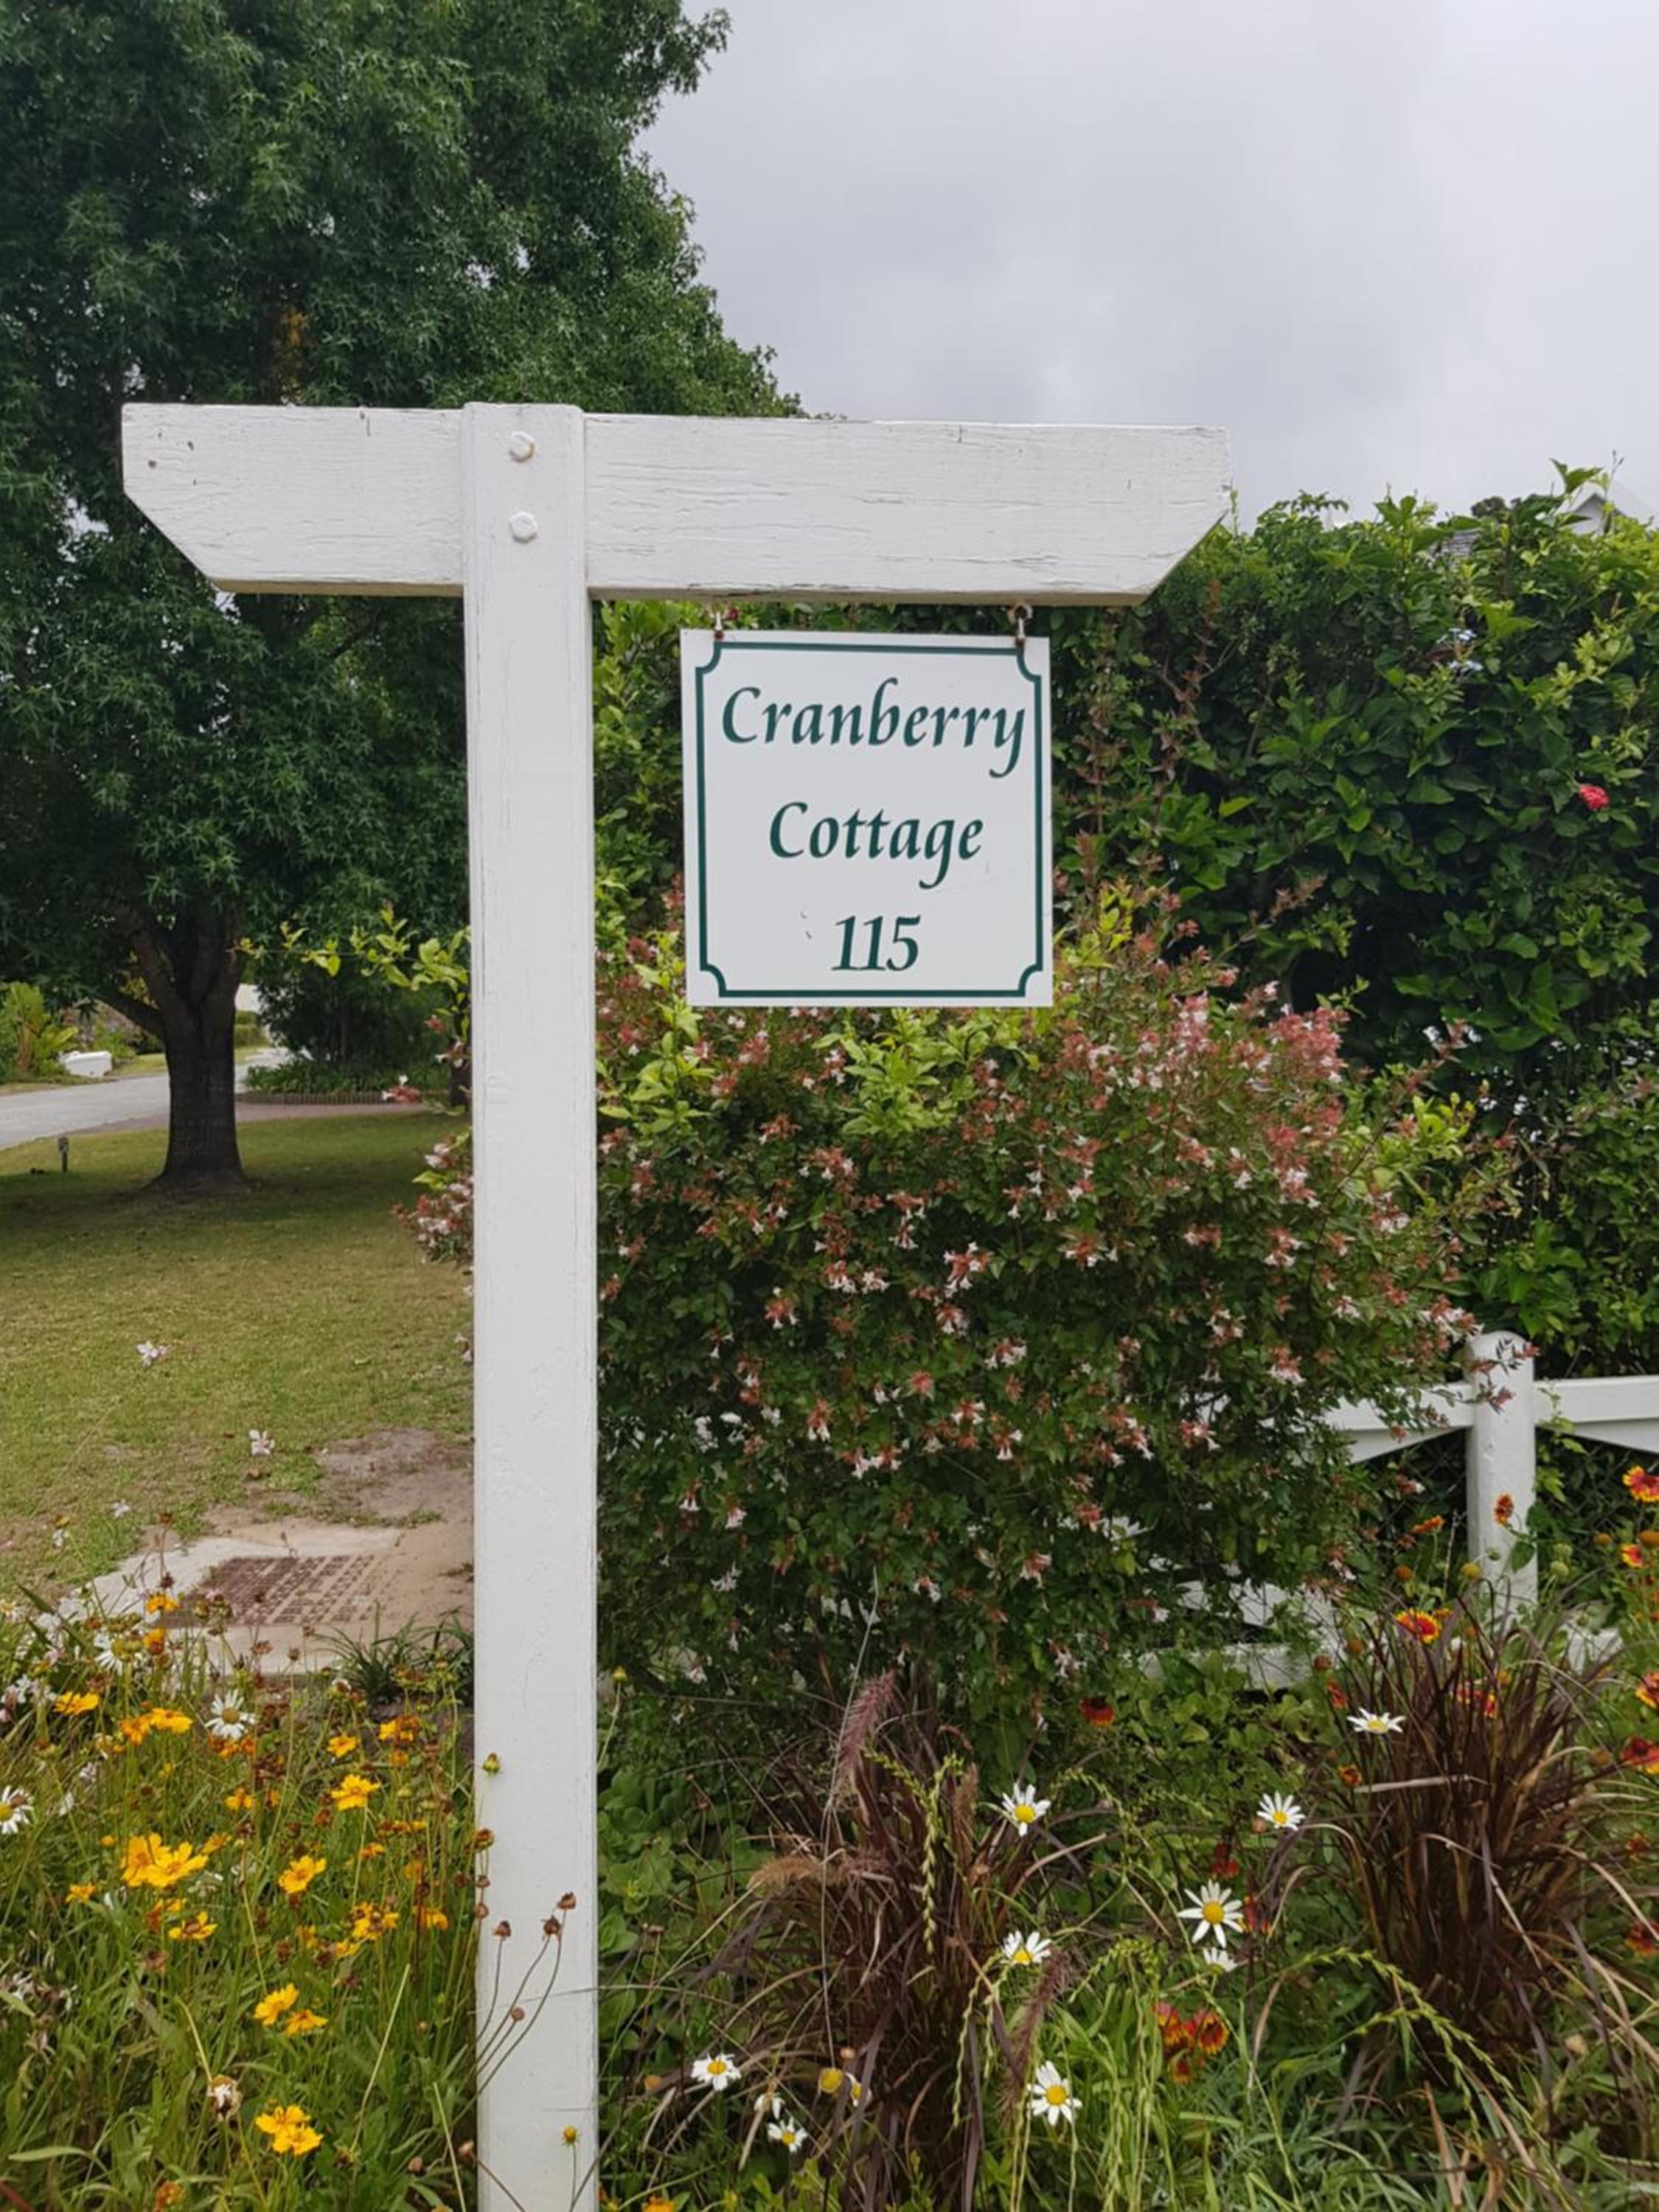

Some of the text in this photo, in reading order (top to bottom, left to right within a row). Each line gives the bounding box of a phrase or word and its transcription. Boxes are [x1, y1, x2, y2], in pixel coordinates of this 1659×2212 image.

[722, 677, 1026, 779] Cranberry
[769, 801, 984, 889] Cottage
[831, 914, 921, 972] 115
